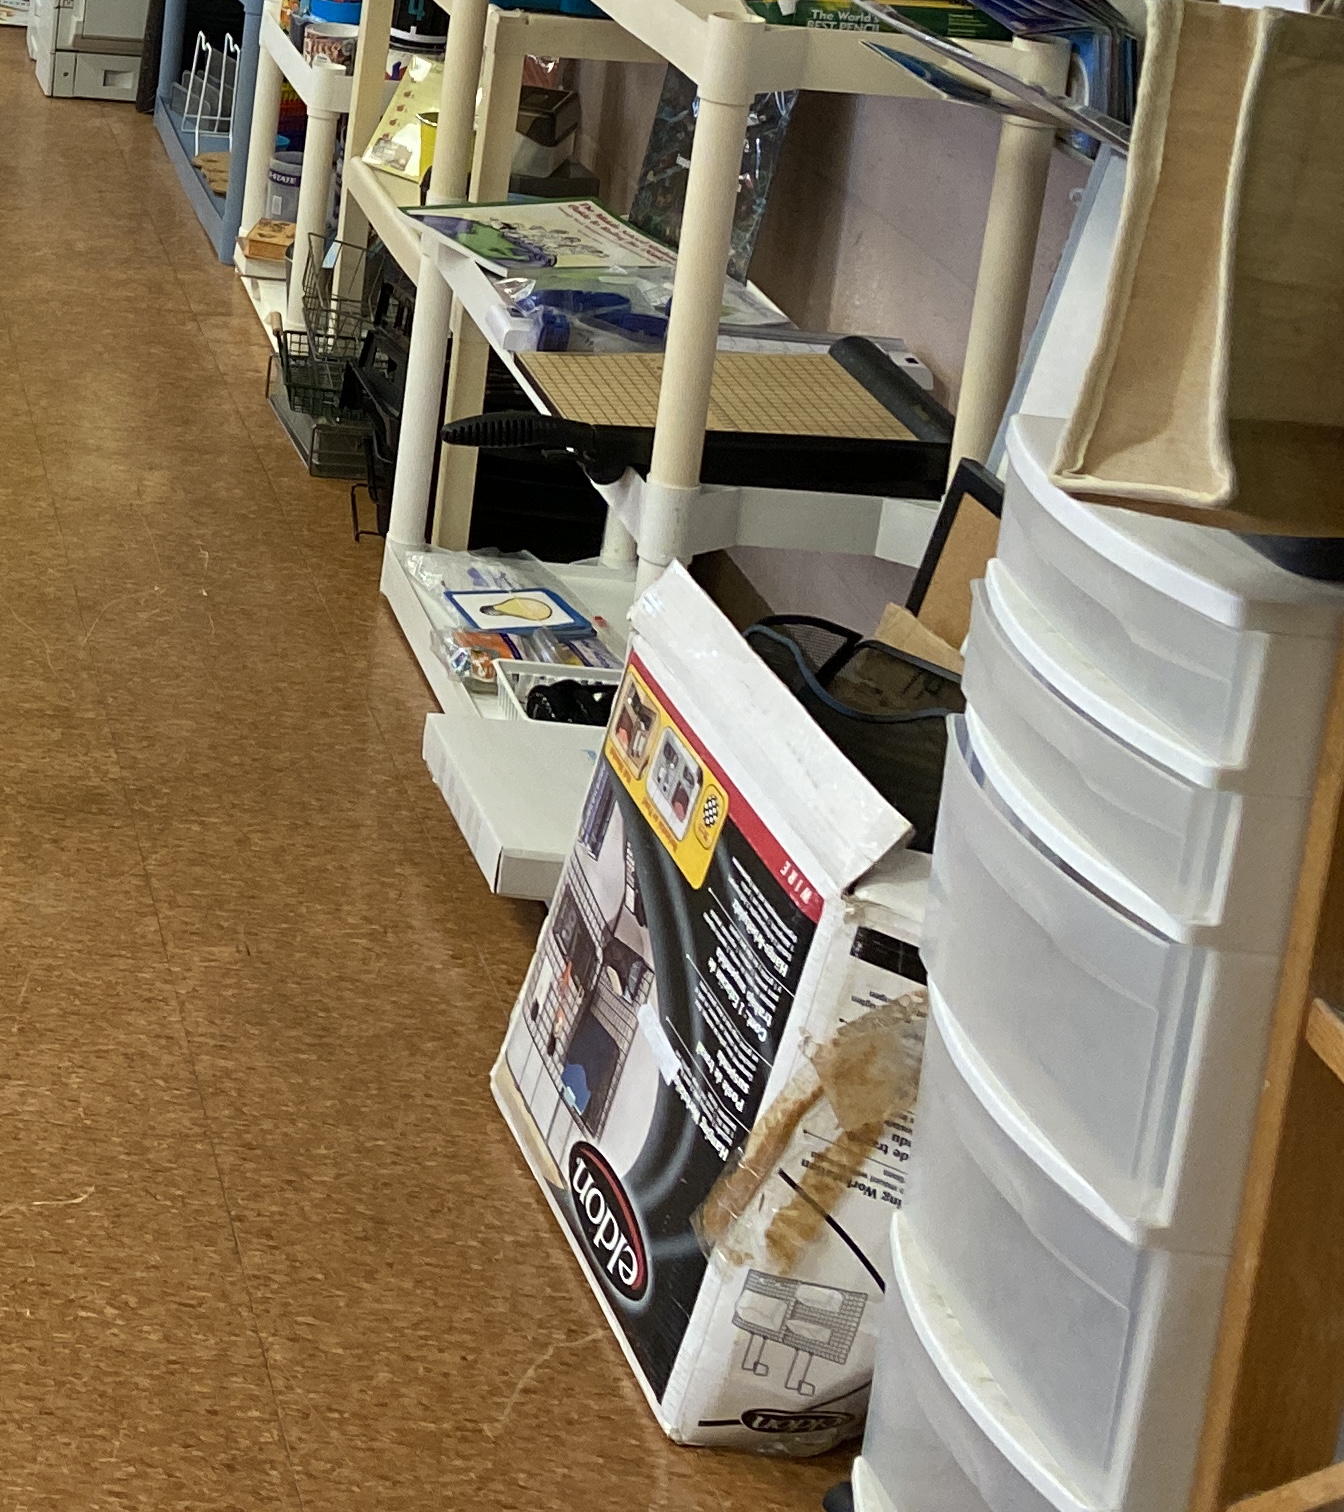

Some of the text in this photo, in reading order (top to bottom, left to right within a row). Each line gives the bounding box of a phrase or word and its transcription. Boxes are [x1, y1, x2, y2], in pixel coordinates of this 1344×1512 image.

[811, 9, 880, 23] The World's
[807, 20, 838, 30] BEST
[779, 861, 814, 905] WIRE
[890, 1148, 909, 1163] de
[571, 1158, 635, 1287] eldon
